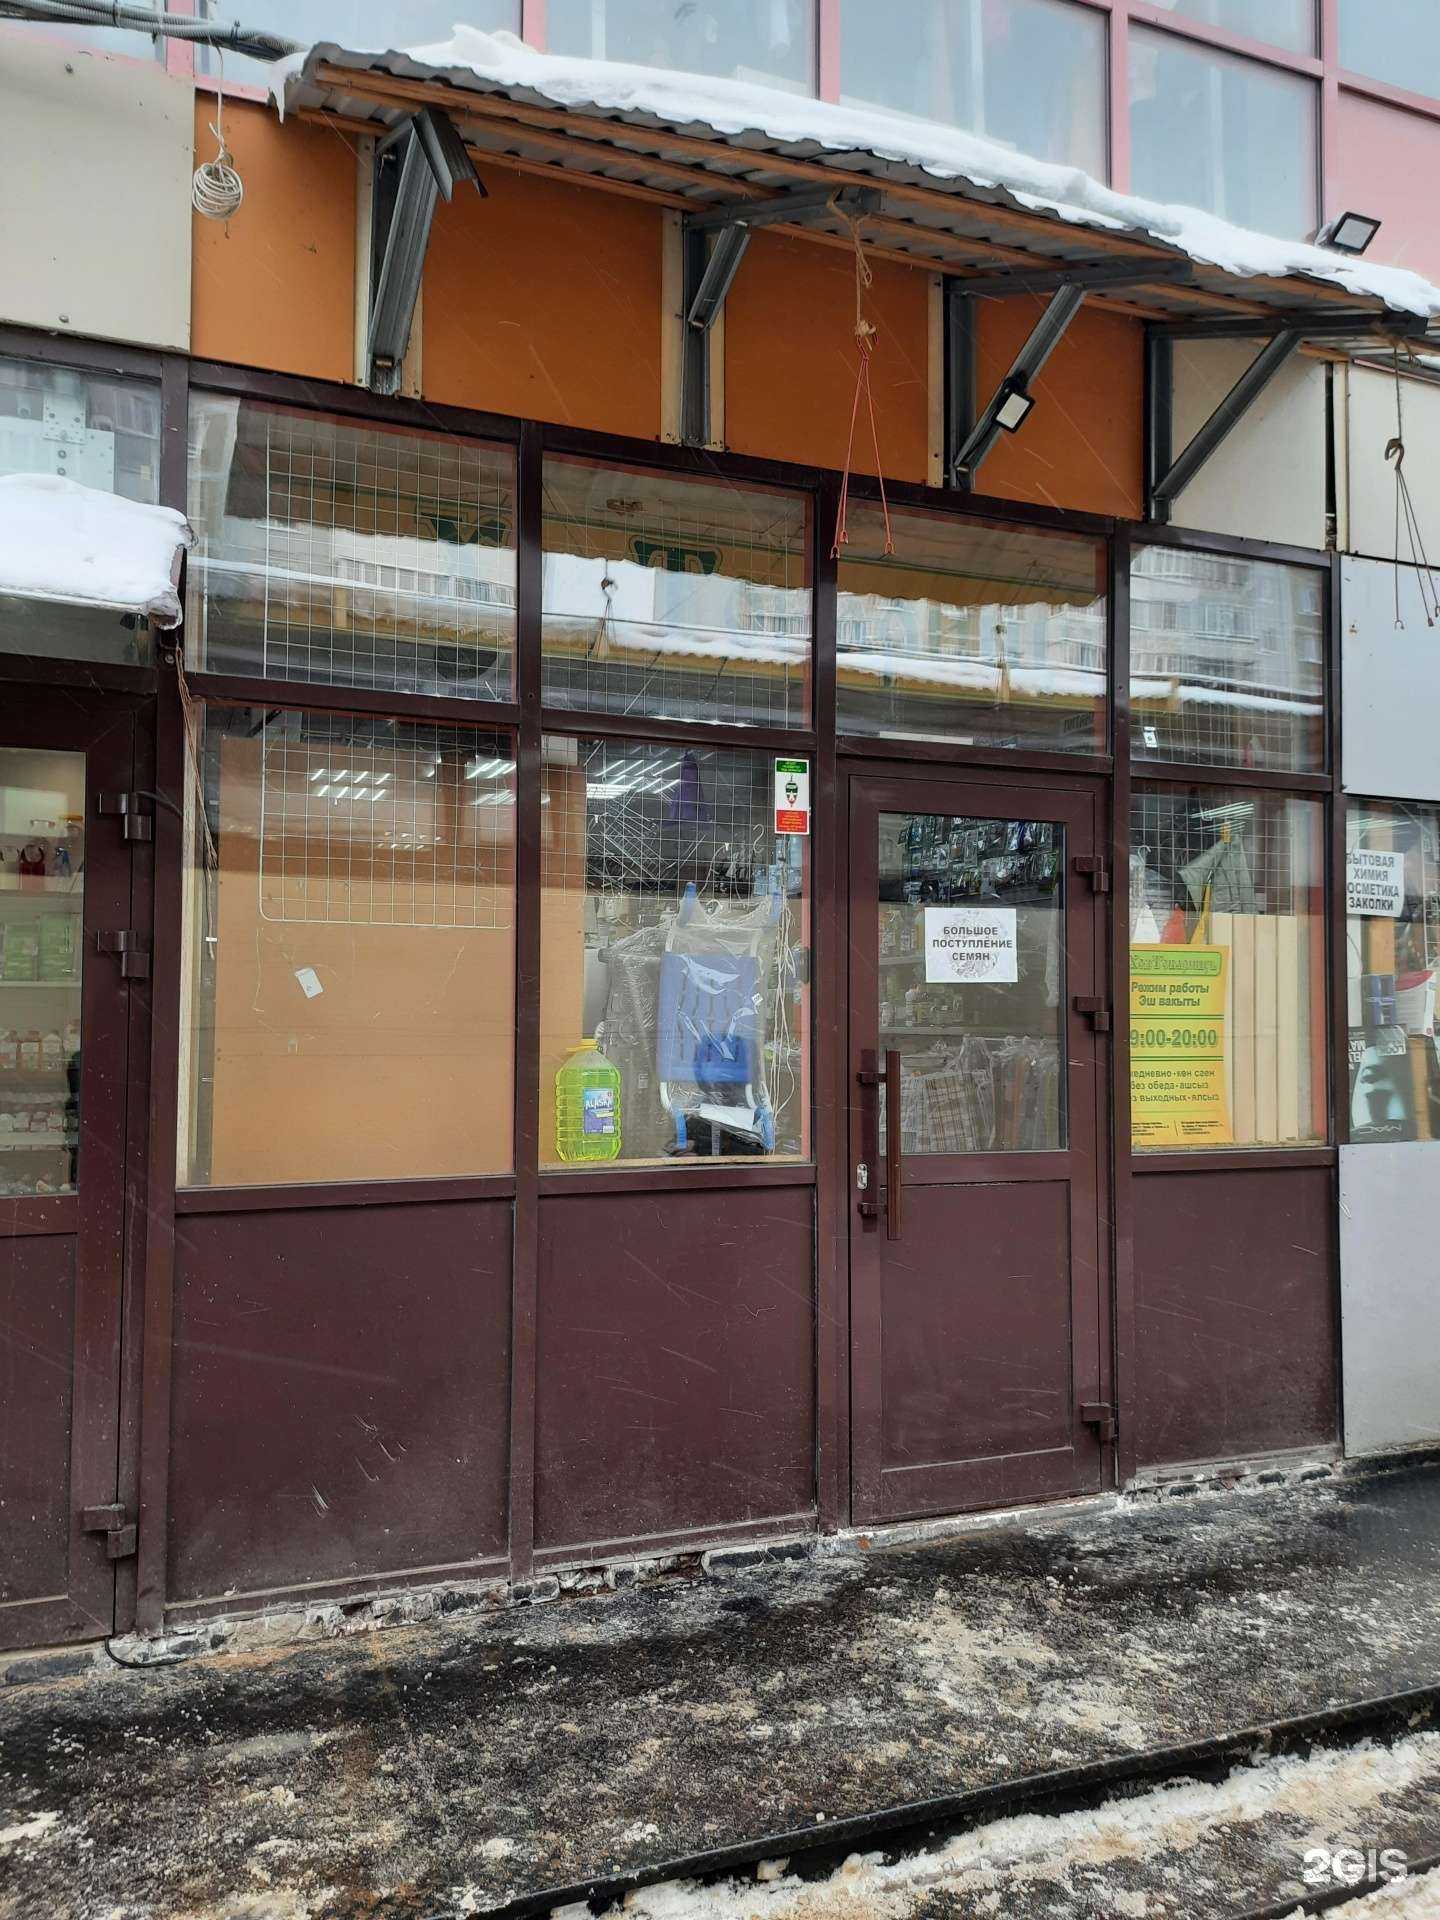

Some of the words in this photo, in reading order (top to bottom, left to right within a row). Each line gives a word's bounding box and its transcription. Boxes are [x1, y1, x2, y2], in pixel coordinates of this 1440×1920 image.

[1353, 868, 1388, 881] ХИМИЯ
[1347, 882, 1399, 897] ОСМЕТИКА
[1349, 897, 1393, 910] ЗАКОЛКИ
[943, 927, 998, 935] БОЛЬШОЕ
[932, 939, 1013, 948] ПОСТУПЛЕНИЕ
[952, 953, 990, 961] СЕМЯН
[1169, 982, 1209, 995] работы
[1131, 1070, 1172, 1078] едневно
